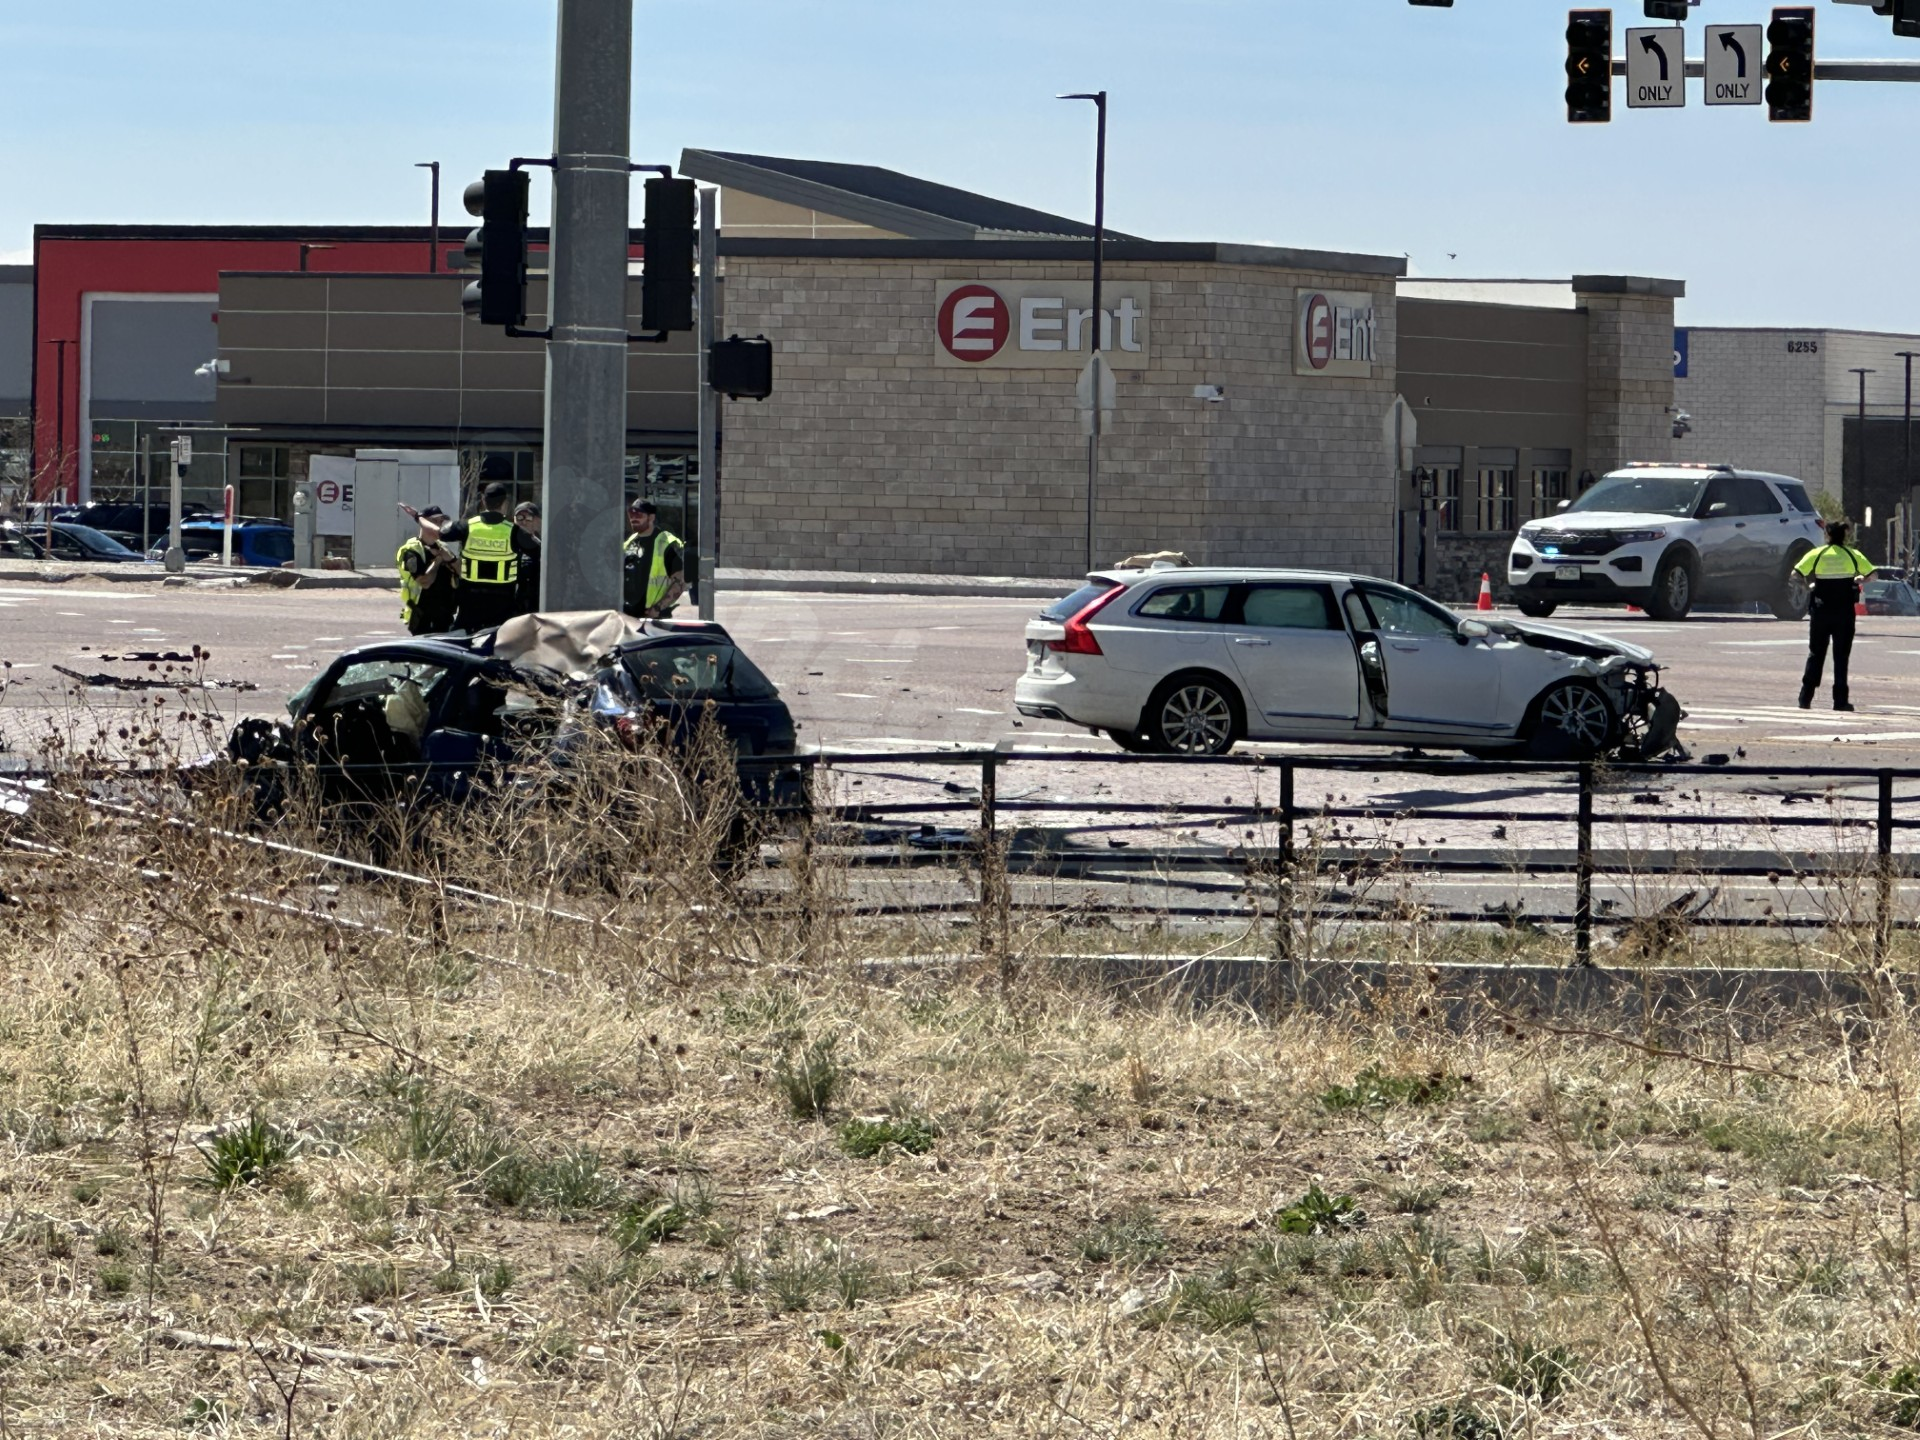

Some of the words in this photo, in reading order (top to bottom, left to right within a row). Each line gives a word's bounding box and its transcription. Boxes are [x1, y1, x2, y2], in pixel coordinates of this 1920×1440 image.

[1638, 86, 1672, 101] ONLY
[1715, 84, 1750, 99] ONLY
[1019, 297, 1143, 352] Ent
[1335, 306, 1376, 361] Ent
[1787, 340, 1818, 354] 6255
[470, 538, 505, 549] POLICE
